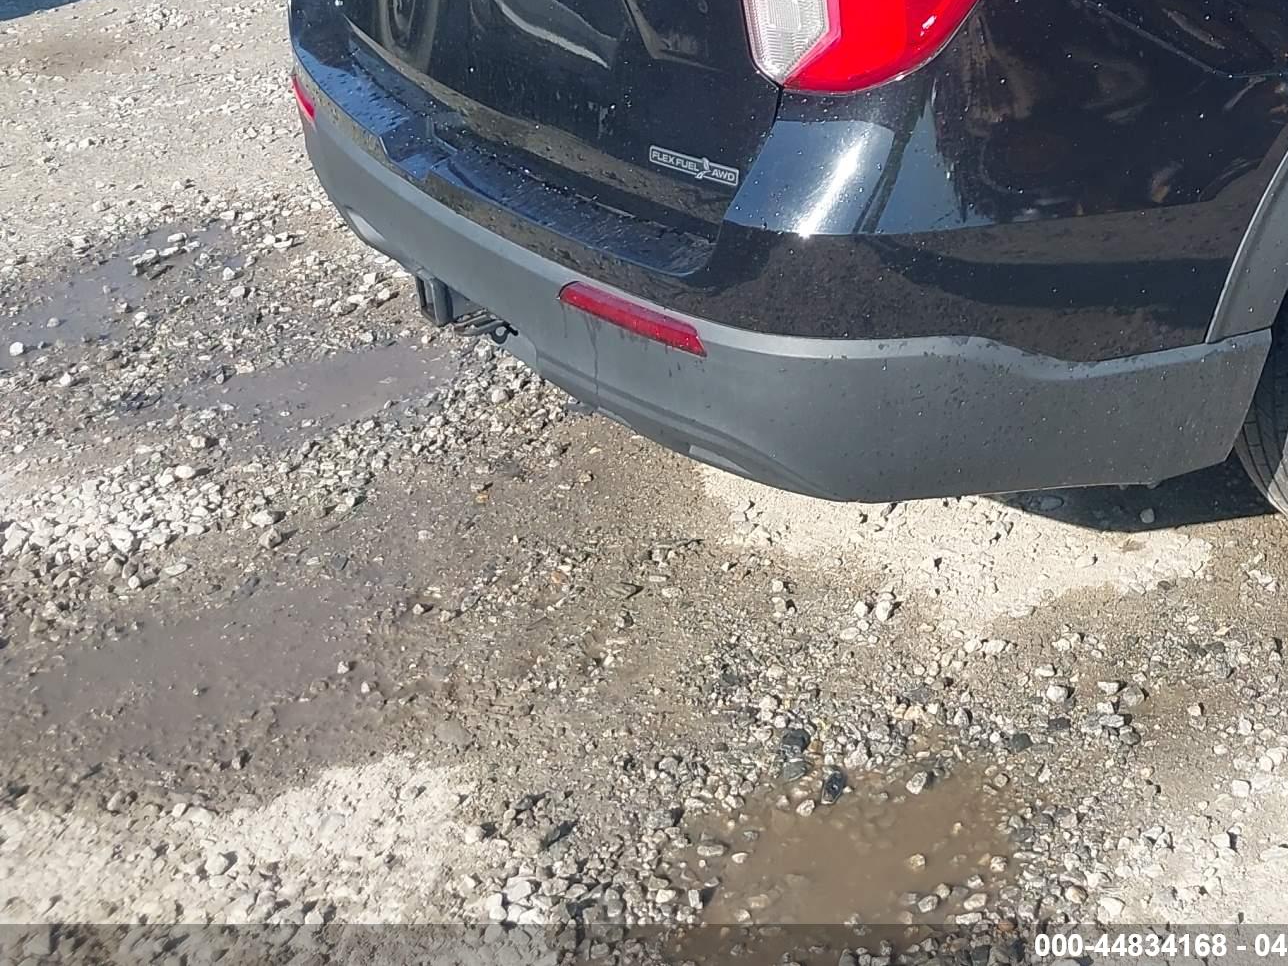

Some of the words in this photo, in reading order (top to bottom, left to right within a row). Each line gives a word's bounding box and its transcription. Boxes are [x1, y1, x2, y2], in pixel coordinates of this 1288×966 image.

[652, 150, 675, 164] FLEX
[675, 158, 700, 172] FUEL
[711, 168, 736, 182] AWD
